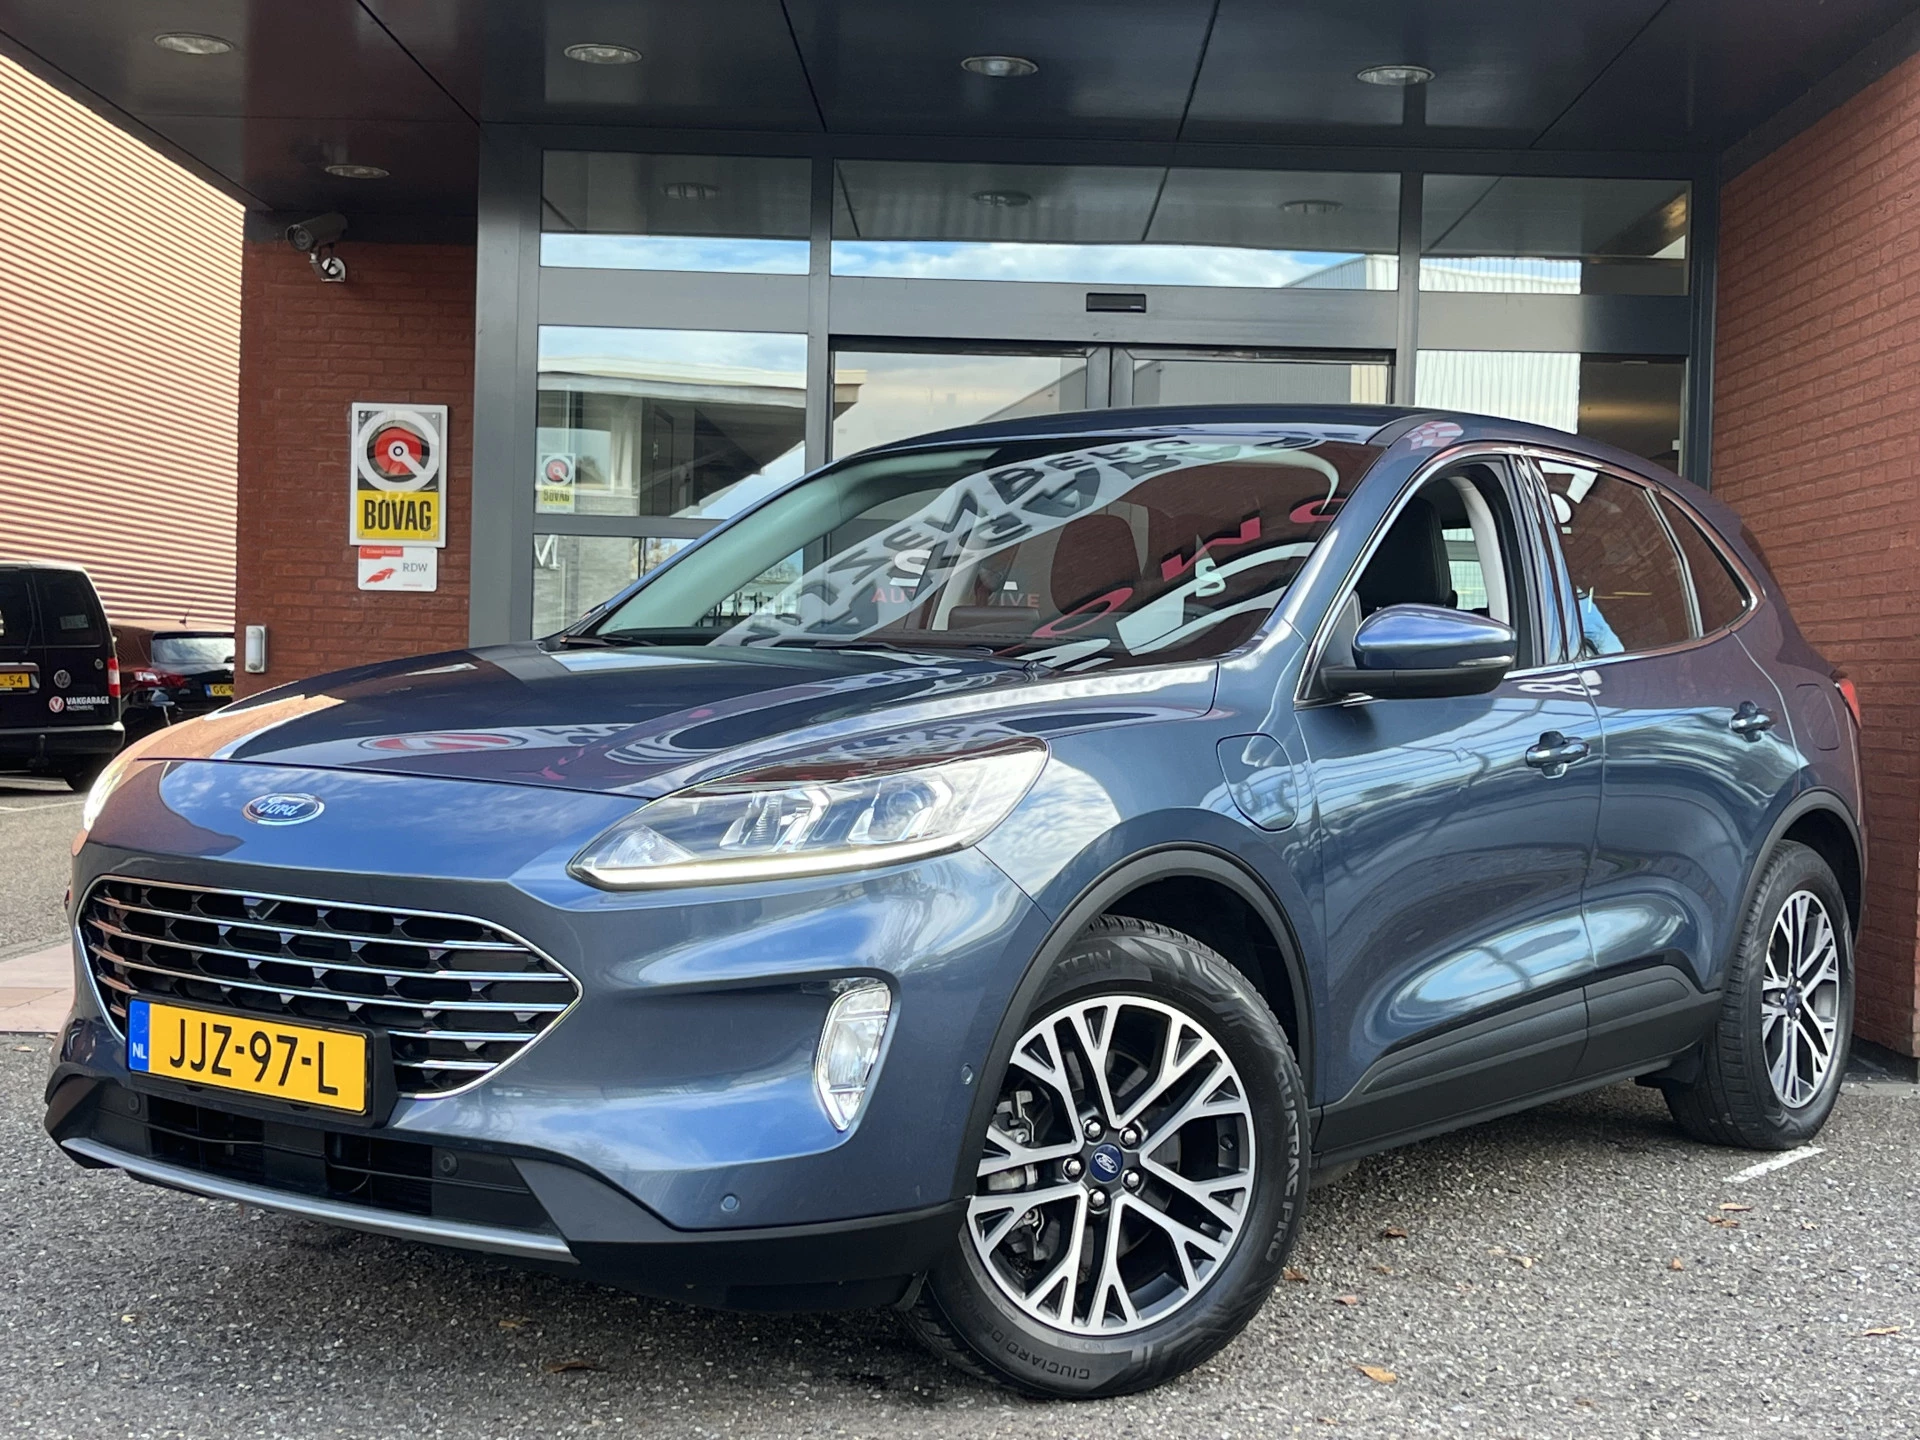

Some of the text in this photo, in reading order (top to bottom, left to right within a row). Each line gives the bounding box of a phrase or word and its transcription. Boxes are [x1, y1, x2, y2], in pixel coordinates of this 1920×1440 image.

[364, 499, 432, 532] BOVAG
[402, 562, 428, 573] RDW
[66, 695, 110, 706] VAKGARAGE
[256, 796, 306, 817] Ford
[132, 1042, 148, 1060] NL
[169, 1018, 339, 1096] JJZ-97-L
[1265, 1064, 1300, 1264] QUATRAC PRO
[1006, 1342, 1091, 1381] GIUGIARO
